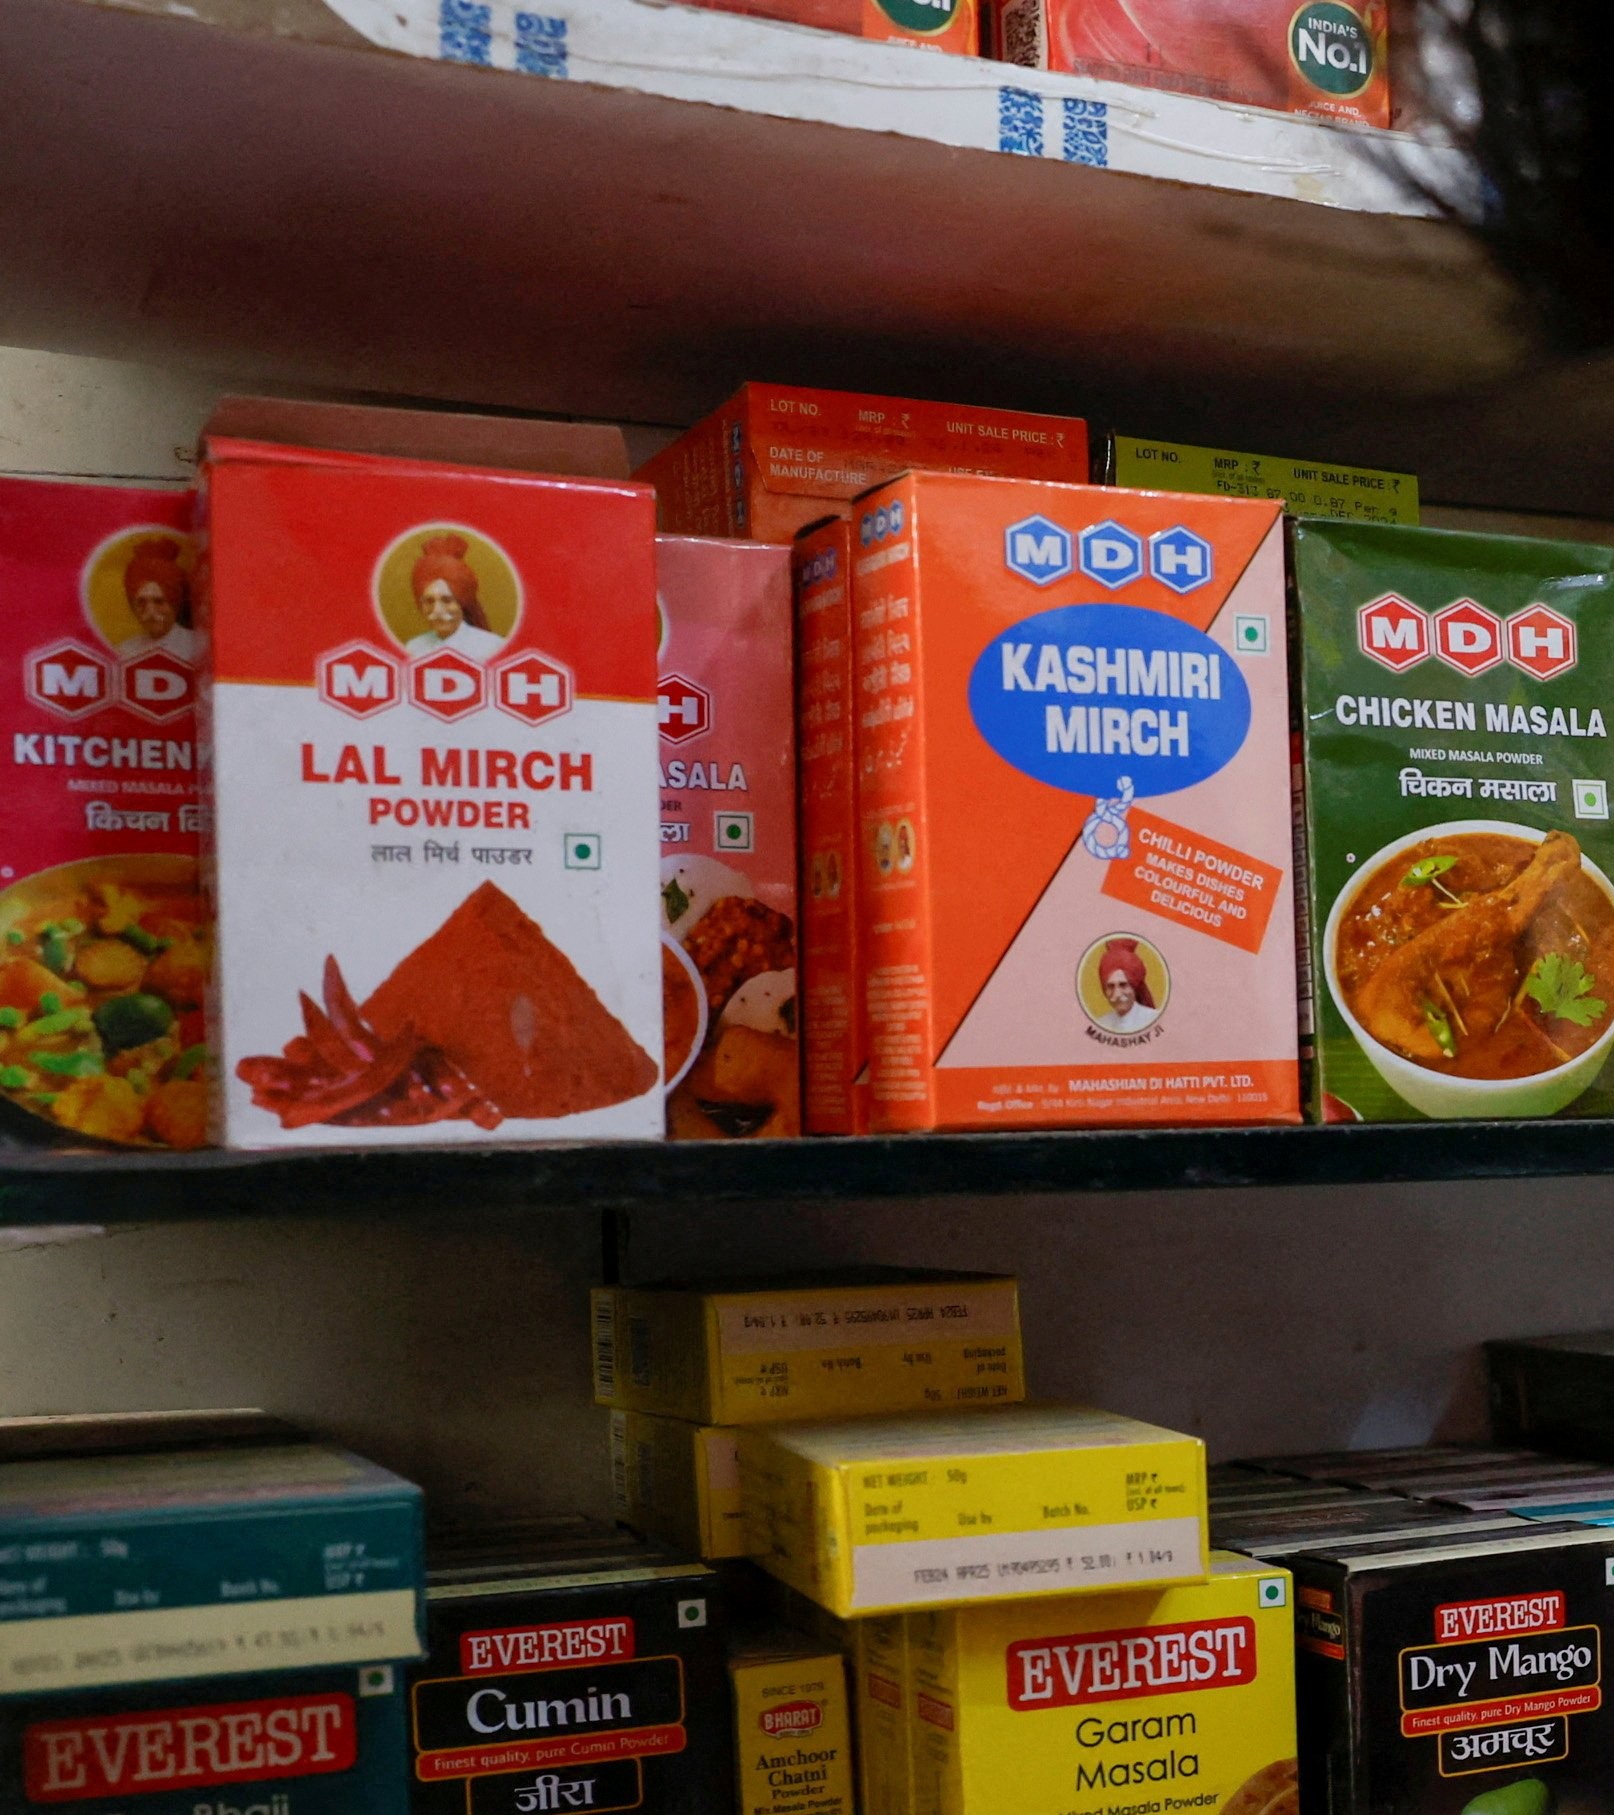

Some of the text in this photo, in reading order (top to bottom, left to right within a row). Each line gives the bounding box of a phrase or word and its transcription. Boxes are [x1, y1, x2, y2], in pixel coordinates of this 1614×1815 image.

[1308, 17, 1359, 39] INDIA'S
[1298, 27, 1367, 74] No.1
[770, 399, 796, 414] LOT
[800, 402, 821, 417] NO.
[858, 409, 886, 424] MRP
[946, 421, 974, 436] UNIT
[977, 425, 1009, 440] SALE
[1012, 429, 1048, 445] PRICE
[769, 447, 825, 463] DATE OF
[769, 464, 868, 485] MANUFACTURE
[1136, 447, 1159, 461] LOT
[1162, 450, 1182, 465] NO.
[1214, 457, 1239, 472] MRP
[1293, 467, 1318, 481] UNIT
[1321, 471, 1349, 486] SALE
[1352, 475, 1385, 490] PRICE
[1015, 532, 1203, 576] MDH
[1371, 616, 1565, 659] MDH
[332, 663, 560, 706] MDH
[1001, 641, 1222, 700] KASHMIRI
[1045, 704, 1190, 757] MIRCH
[1335, 694, 1607, 738] CHICKEN MASALA
[13, 732, 192, 771] KITCHEN
[301, 742, 593, 791] LAL MIRCH
[1409, 747, 1544, 766] MIXED MASALA POWDER
[1398, 766, 1557, 803] चिकन मसाला
[368, 797, 531, 829] POWDER
[371, 841, 411, 865] लाल
[1138, 828, 1264, 890] CHILLI POWDER
[1133, 865, 1247, 920] COLOURFUL AND
[1145, 852, 1245, 901] MAKES DISHES
[1151, 889, 1224, 928] DELICIOUS
[1084, 1026, 1152, 1049] MAHASHAY
[1068, 1079, 1145, 1093] MAHASHIAN
[1165, 1076, 1200, 1090] HATTI
[1202, 1076, 1228, 1088] PVT.
[1229, 1075, 1254, 1088] LTD.
[1440, 1596, 1560, 1639] EVEREST
[468, 1621, 627, 1671] EVEREST
[1016, 1625, 1247, 1701] EVEREST
[1409, 1643, 1592, 1698] Dry Mango
[466, 1686, 632, 1734] Cumin
[764, 1707, 818, 1731] BHARAT
[1075, 1711, 1197, 1748] Garam
[1412, 1715, 1441, 1730] Finest
[1481, 1708, 1503, 1722] pure
[1504, 1703, 1522, 1719] Dry
[1523, 1698, 1556, 1714] Mango
[1557, 1694, 1591, 1709] Powder
[41, 1703, 342, 1792] EVEREST
[434, 1755, 477, 1773] Finest
[536, 1746, 566, 1762] pure
[570, 1740, 616, 1757] Cumin
[619, 1733, 670, 1752] Powder
[755, 1748, 838, 1771] Amchoor
[1450, 1722, 1556, 1761] अमचूर
[768, 1764, 828, 1788] Chatni
[1075, 1750, 1200, 1792] Masala
[513, 1773, 597, 1813] जीरा
[771, 1783, 825, 1800] Powder
[1107, 1791, 1221, 1815] Masala Powder
